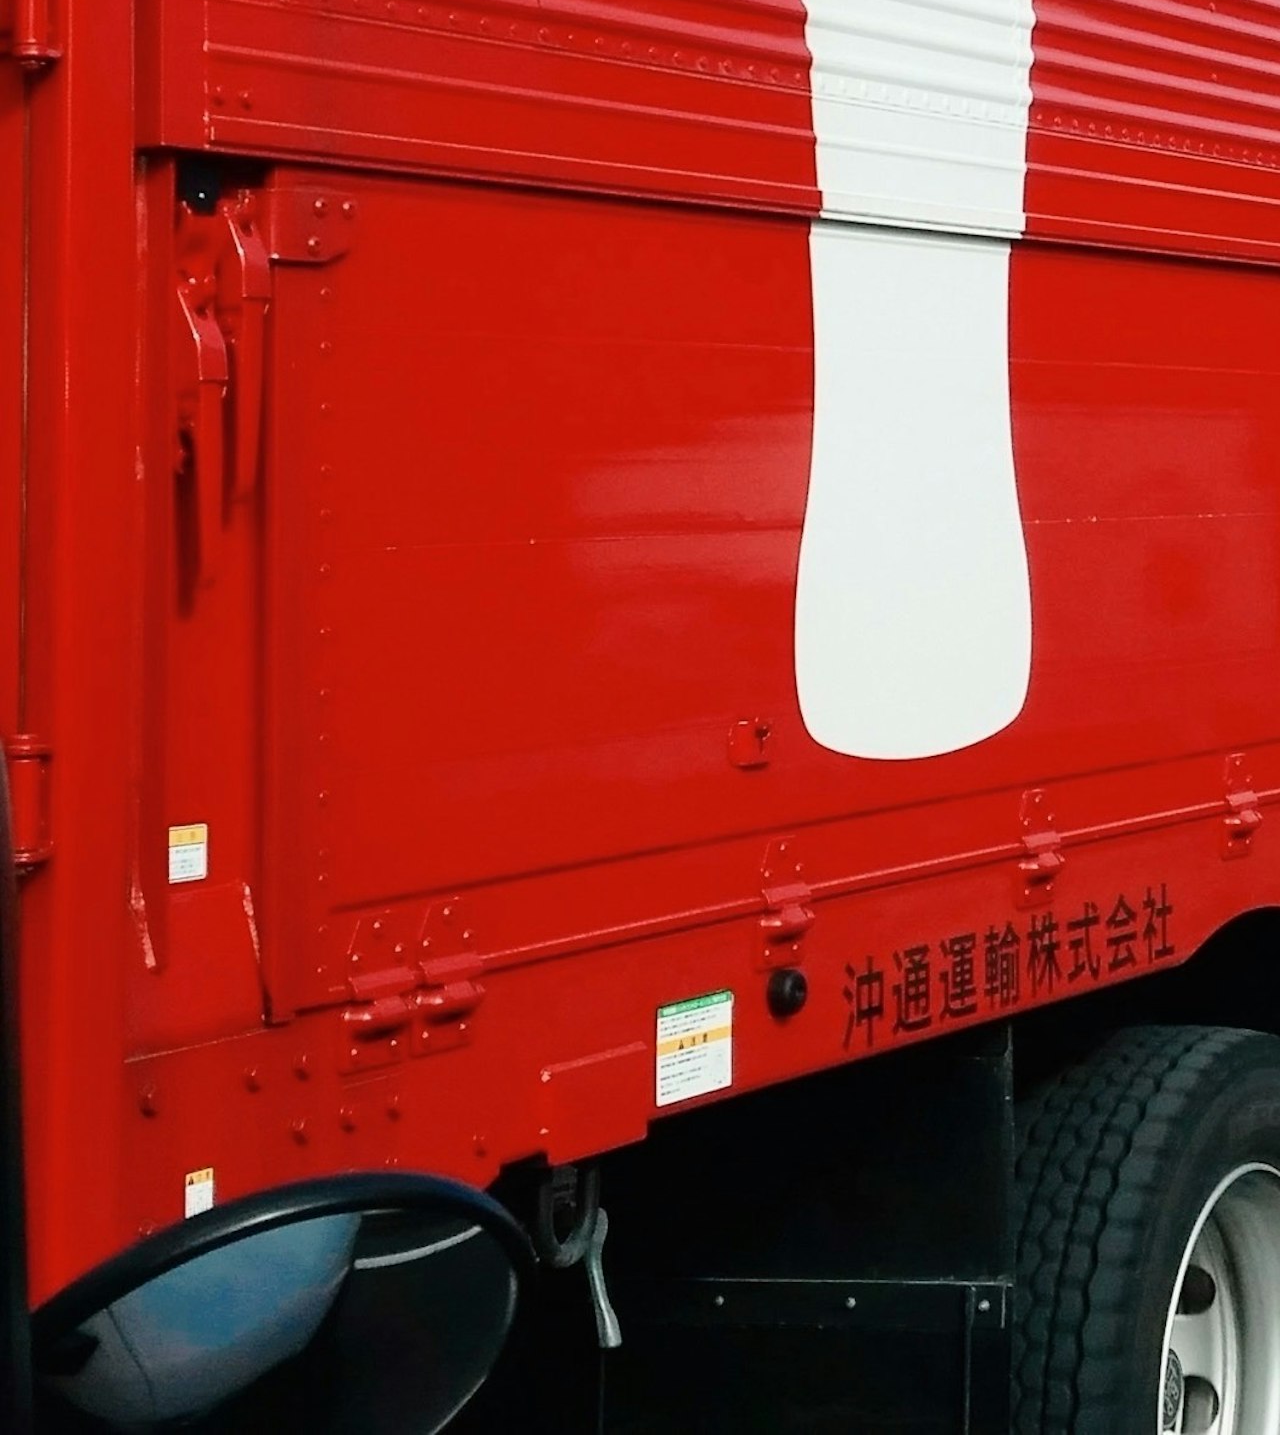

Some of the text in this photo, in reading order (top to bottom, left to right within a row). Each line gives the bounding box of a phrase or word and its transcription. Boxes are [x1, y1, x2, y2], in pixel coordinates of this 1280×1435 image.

[842, 882, 1175, 1049] 沖通運輸株式会社
